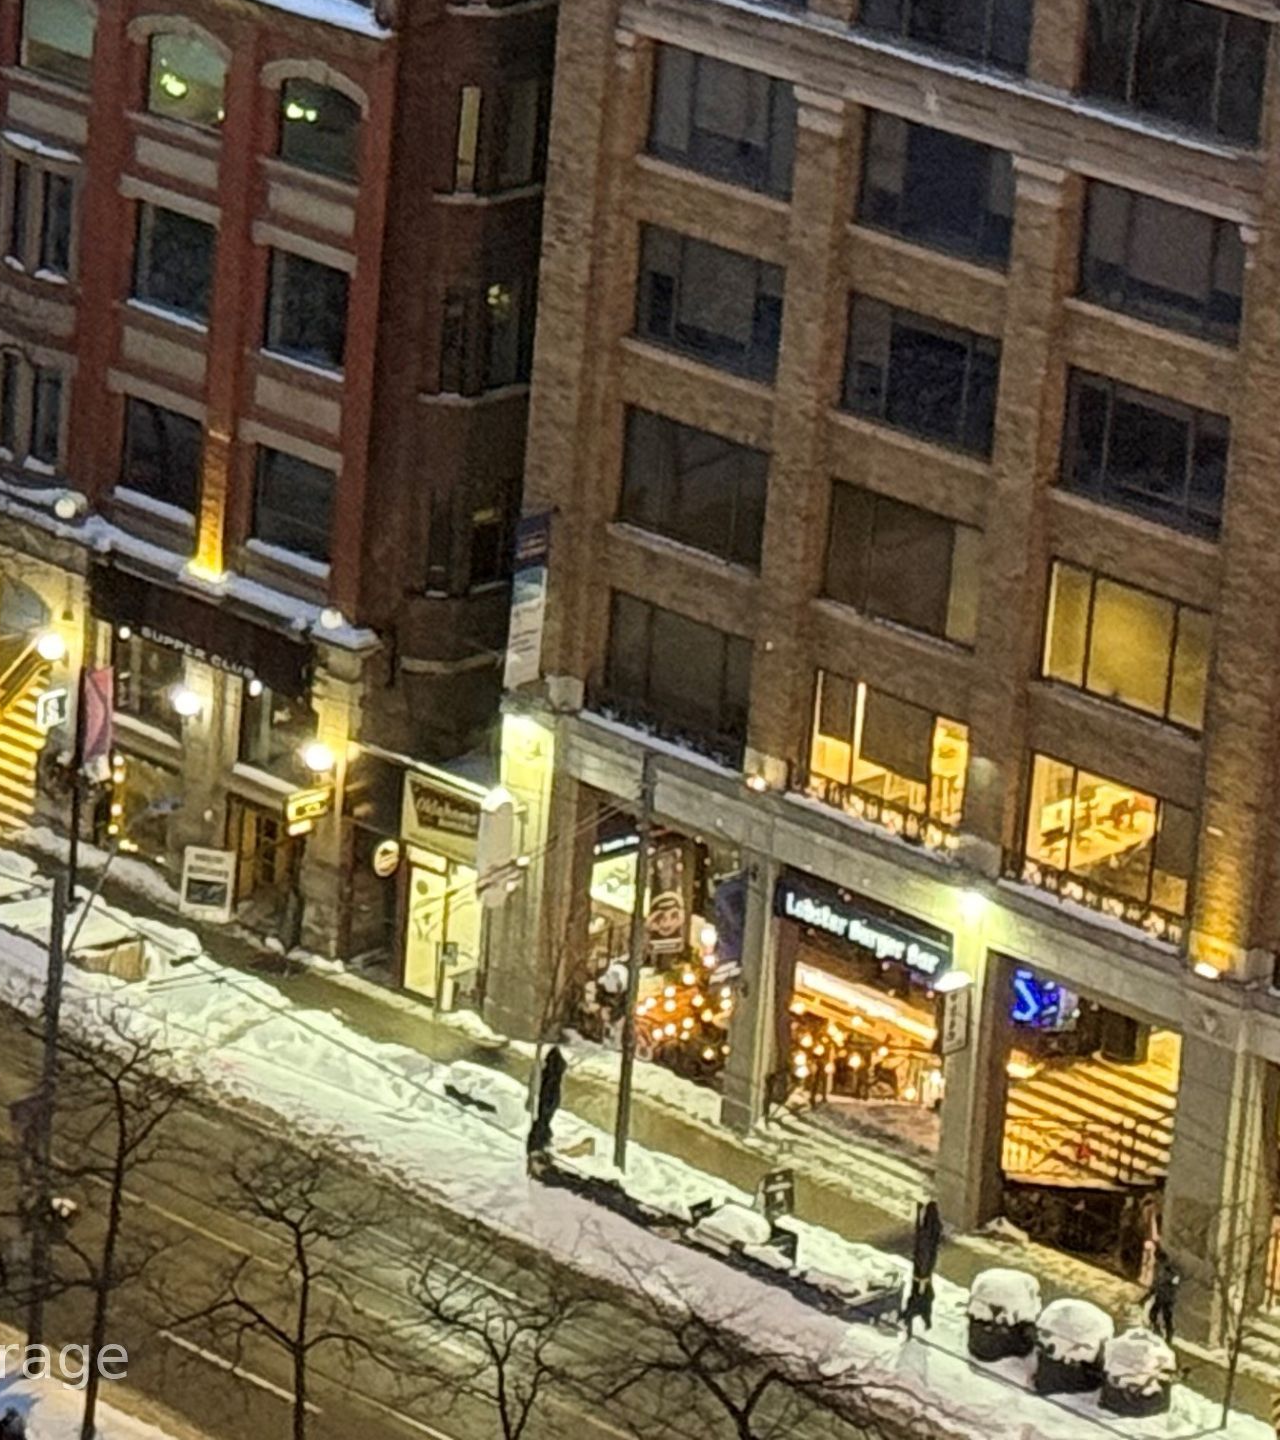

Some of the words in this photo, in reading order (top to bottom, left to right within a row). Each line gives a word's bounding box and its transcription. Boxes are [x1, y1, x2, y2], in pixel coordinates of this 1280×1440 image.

[141, 626, 207, 660] SUPPER
[210, 653, 256, 679] CLUB
[785, 892, 848, 936] Lobster
[848, 919, 906, 960] Burger
[906, 943, 941, 975] Bar
